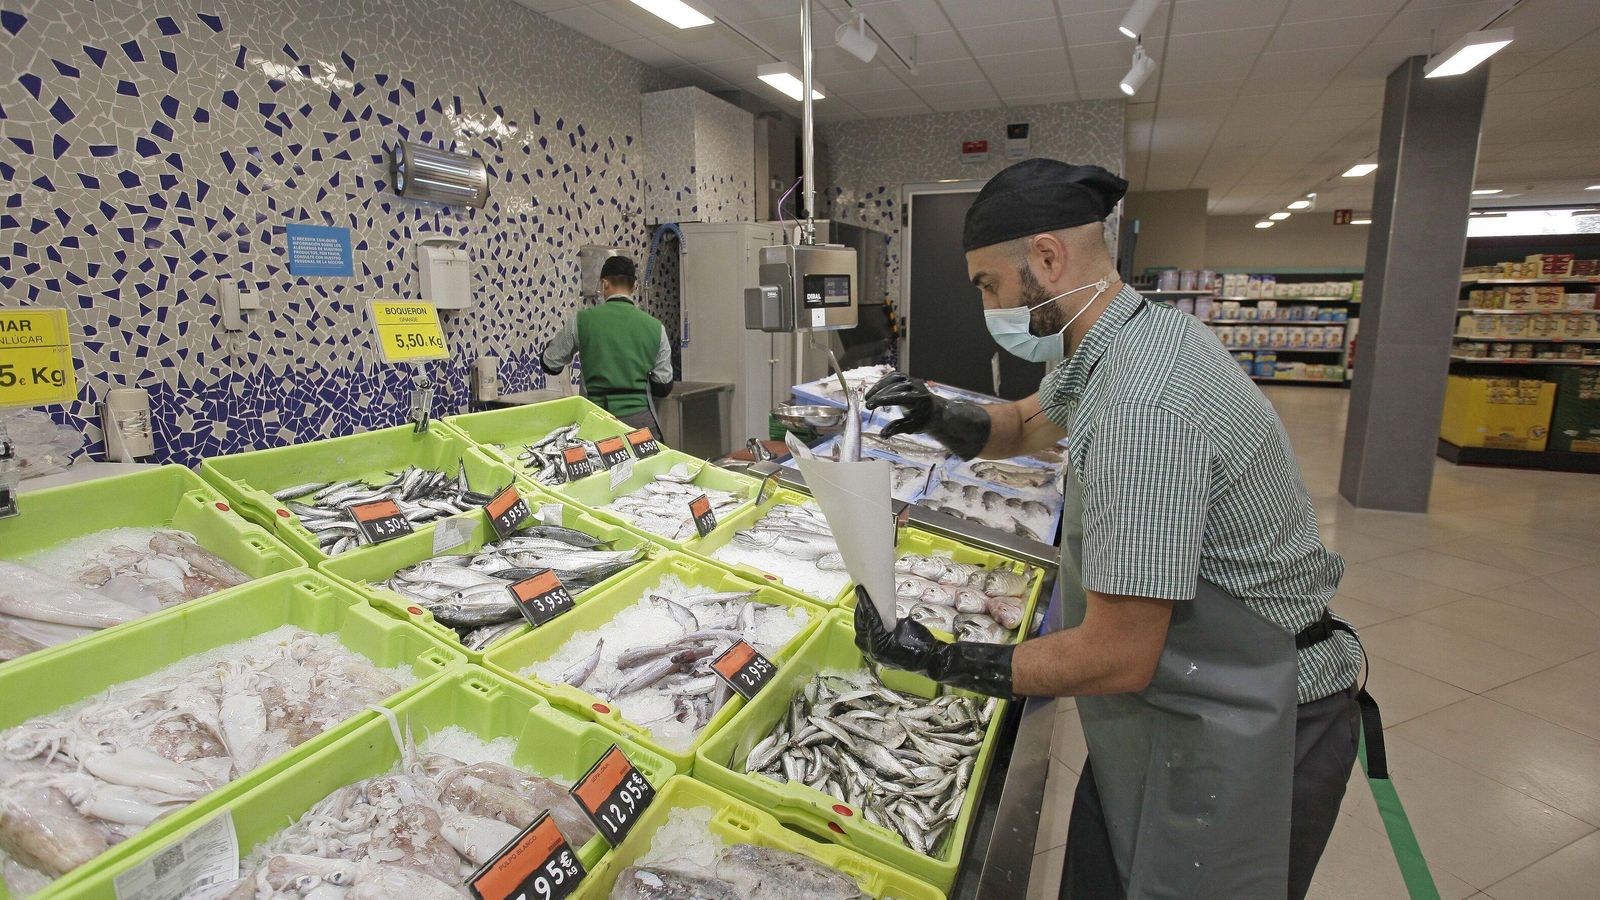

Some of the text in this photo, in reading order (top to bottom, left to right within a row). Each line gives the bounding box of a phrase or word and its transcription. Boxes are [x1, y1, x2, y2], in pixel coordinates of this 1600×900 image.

[385, 307, 428, 315] BOQUERON
[428, 336, 444, 348] Kg
[32, 367, 66, 387] Kg
[498, 854, 517, 872] PULPO
[516, 835, 537, 855] BLANCO
[565, 866, 578, 877] kg
